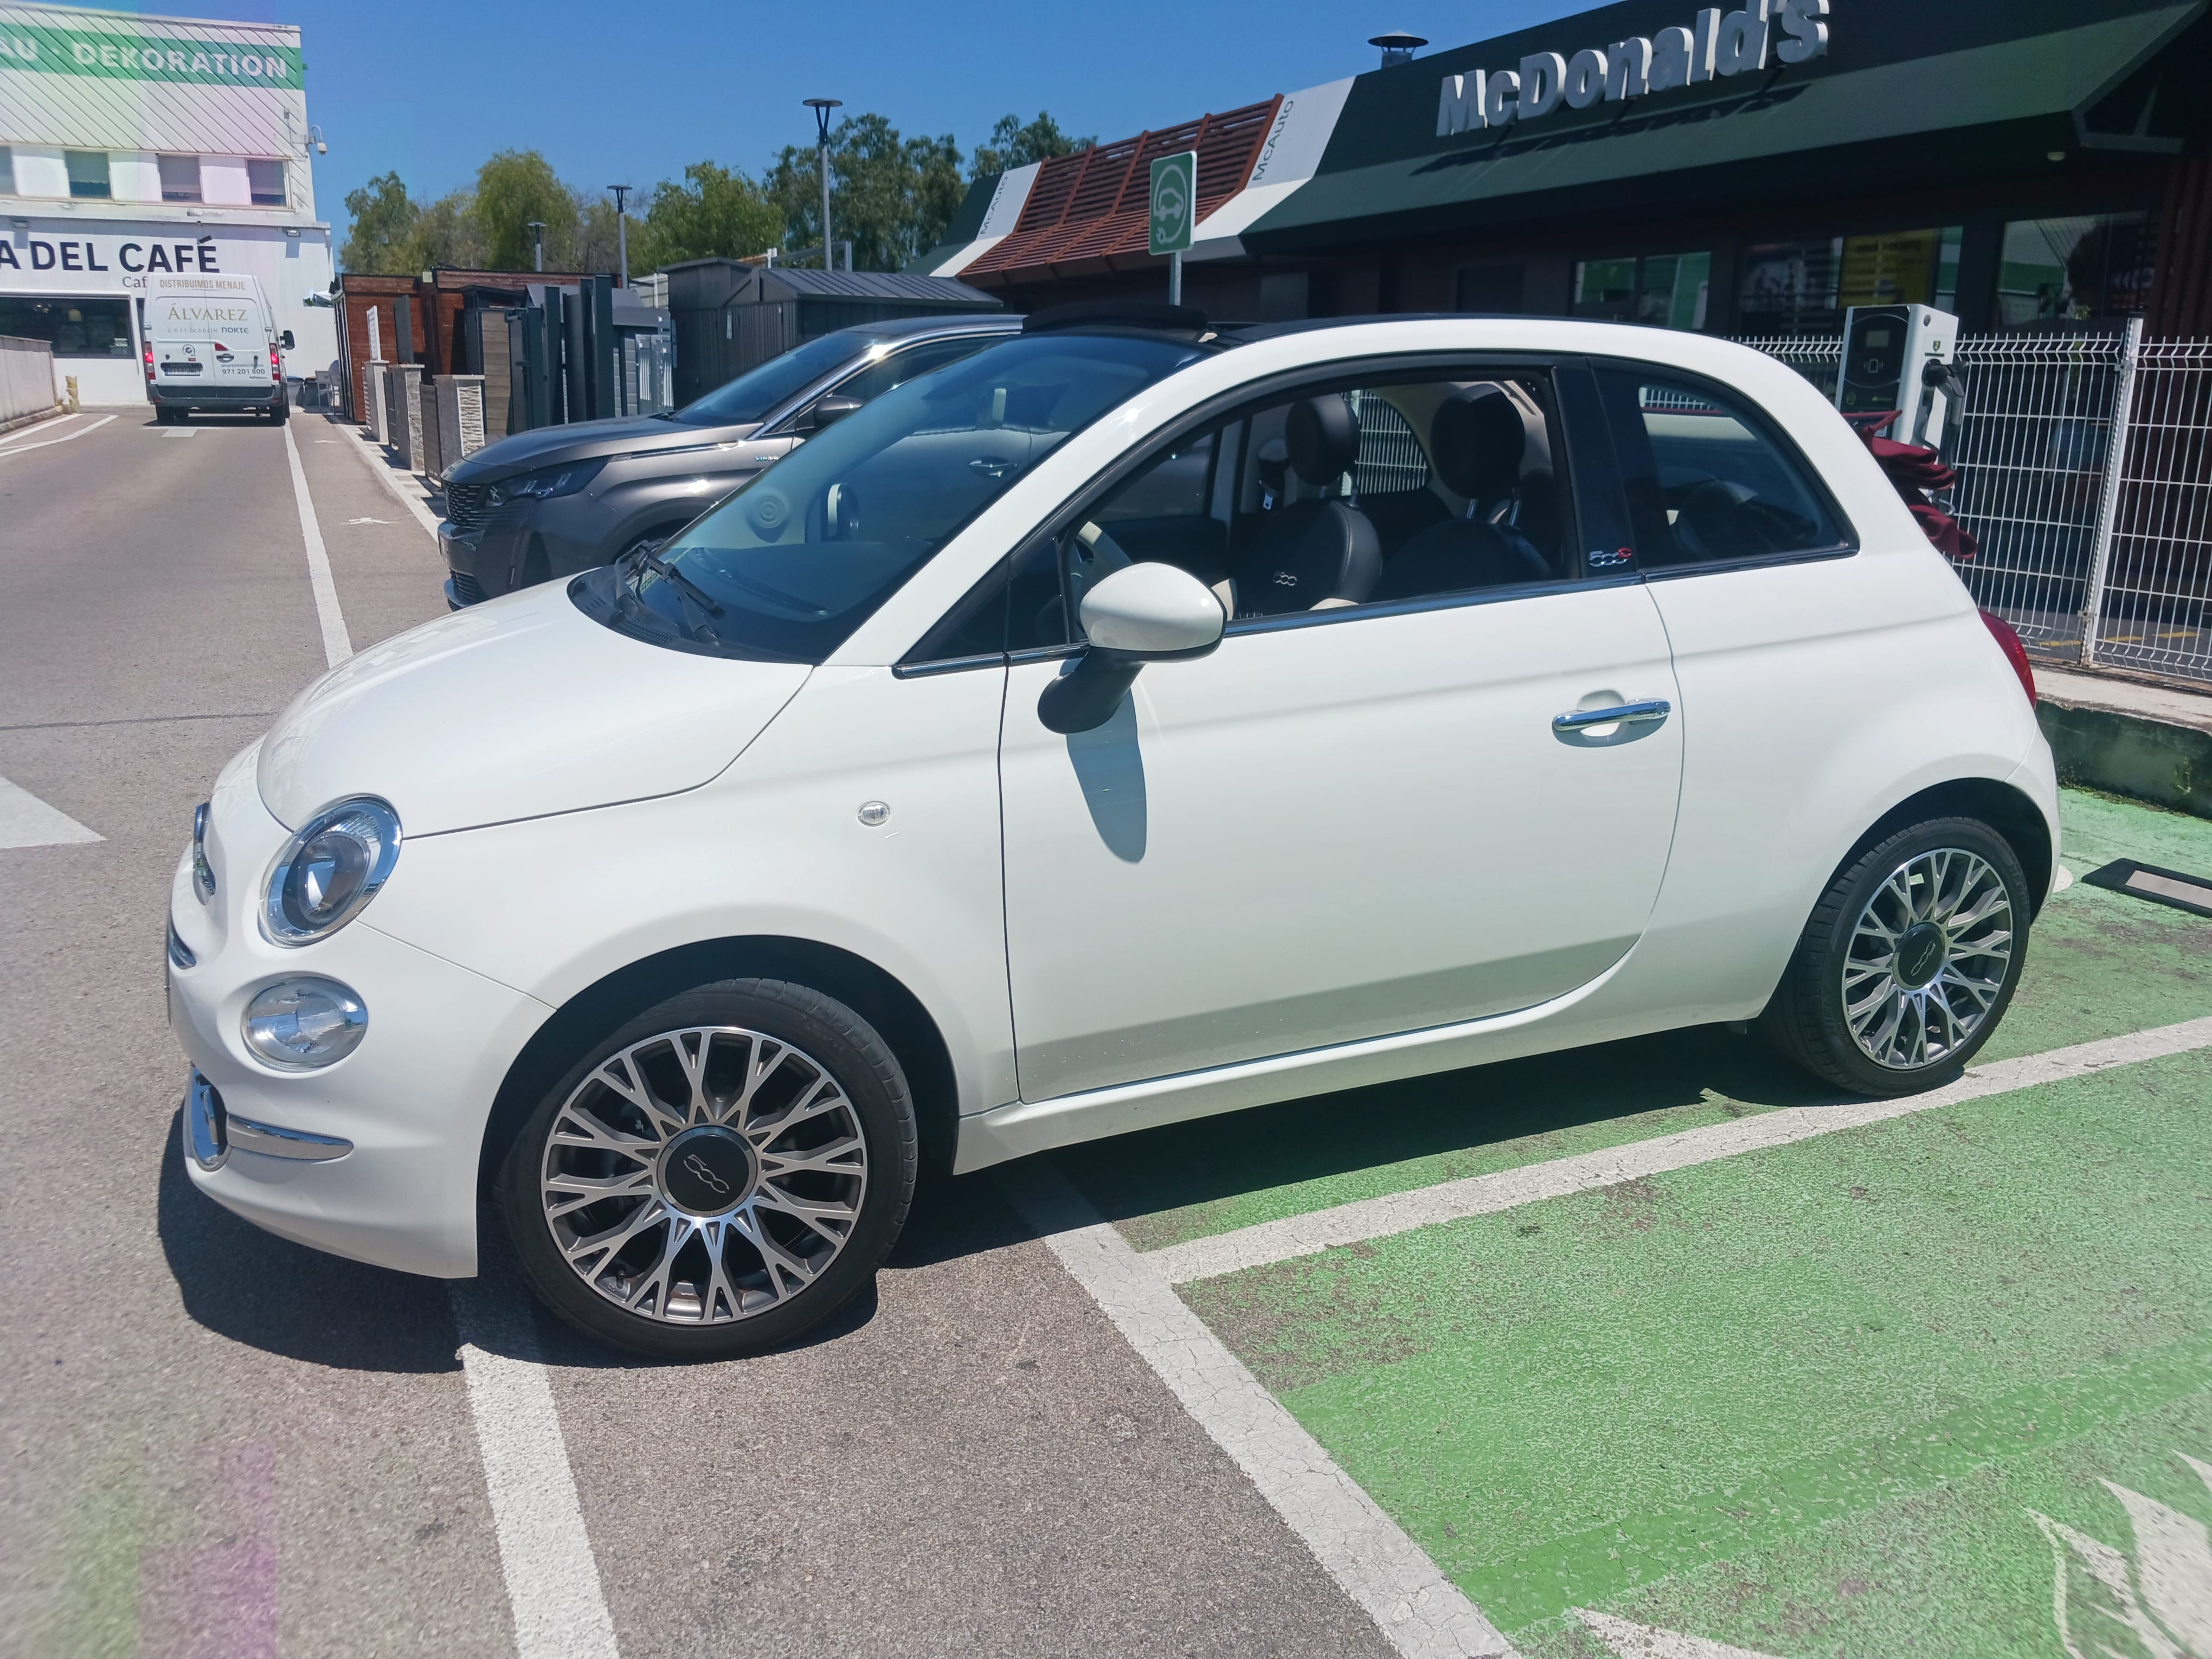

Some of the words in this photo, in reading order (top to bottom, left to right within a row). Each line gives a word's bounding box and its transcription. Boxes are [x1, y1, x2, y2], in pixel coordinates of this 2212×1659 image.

[71, 41, 287, 78] DEKORATION
[1436, 0, 1829, 137] McDonald's
[1252, 100, 1294, 181] McAuto
[29, 240, 109, 271] DEL
[119, 235, 220, 273] CAFÉ
[122, 275, 148, 288] Caf
[159, 279, 214, 289] DISTRIBUIMOS
[216, 281, 246, 291] MENAJE
[168, 303, 248, 321] ÁLVAREZ
[683, 1153, 730, 1194] 500
